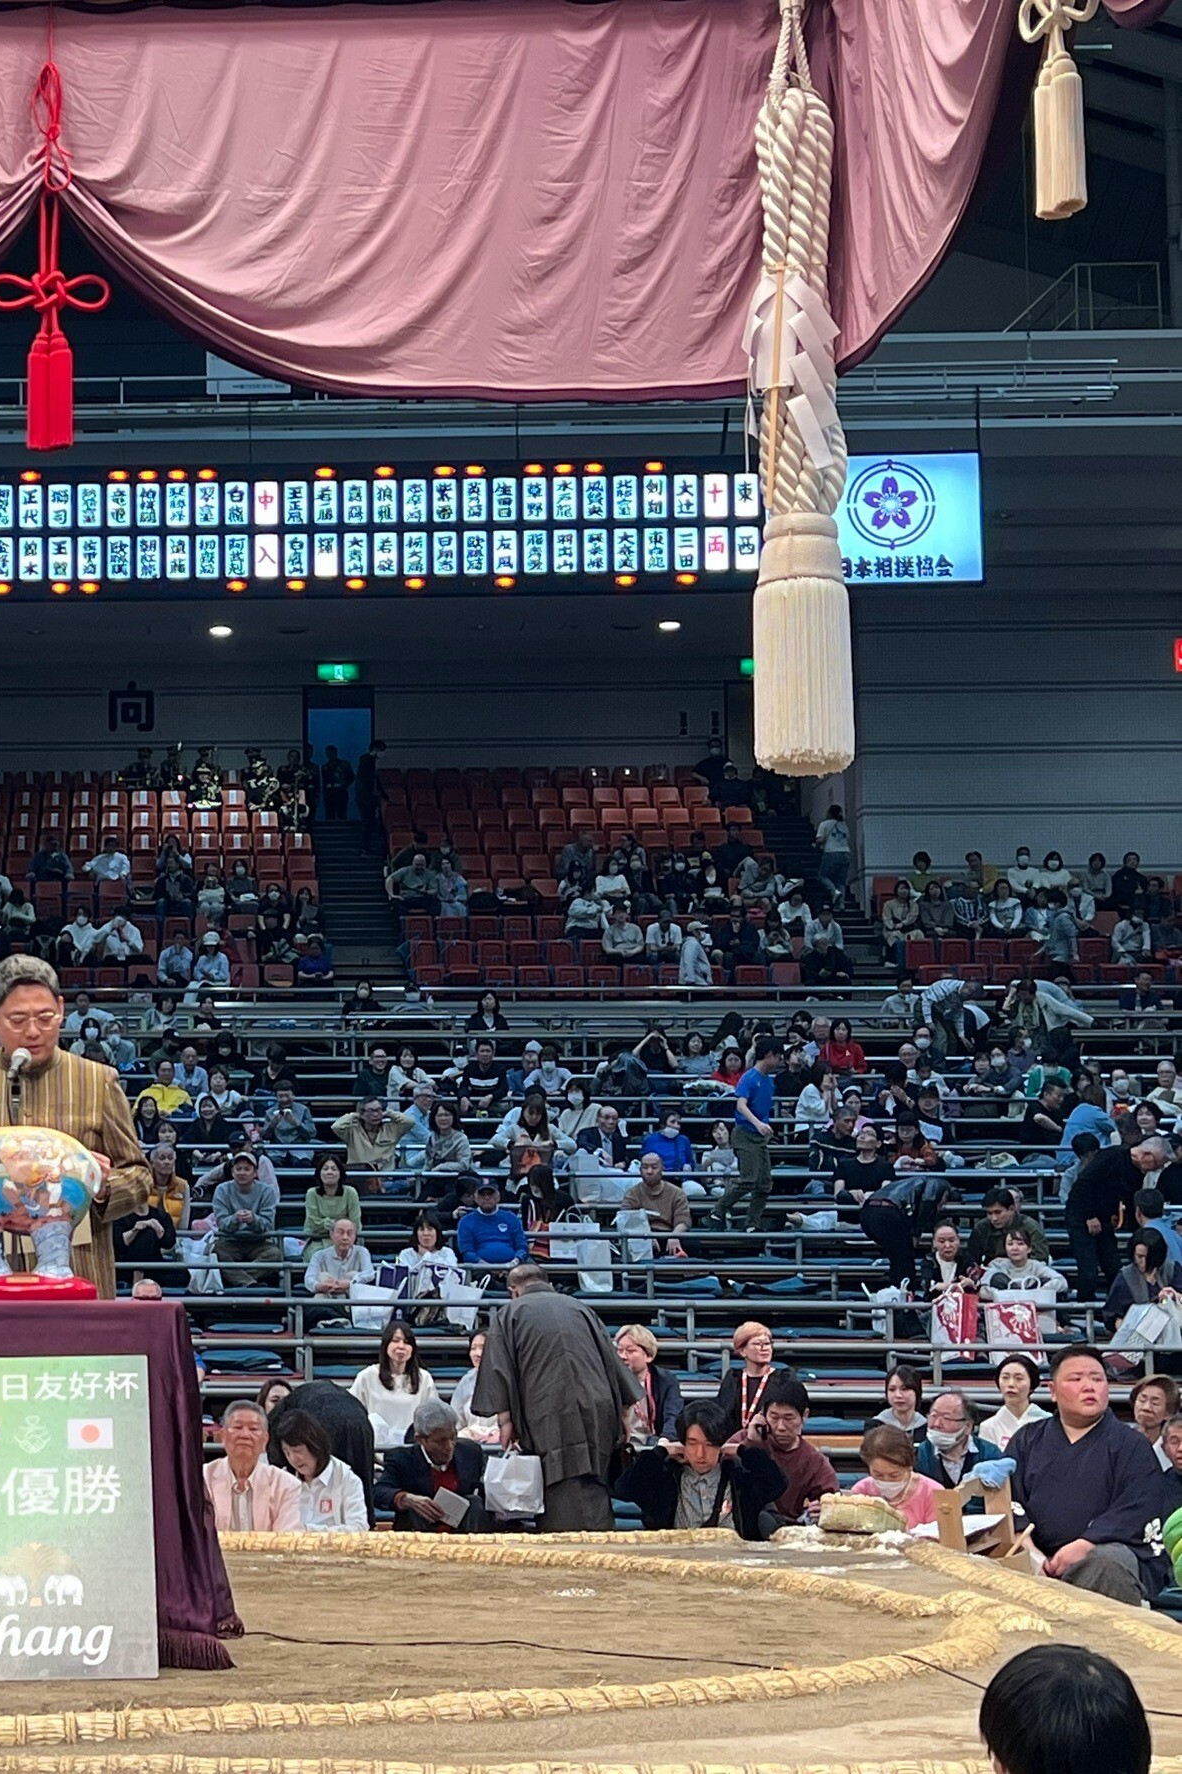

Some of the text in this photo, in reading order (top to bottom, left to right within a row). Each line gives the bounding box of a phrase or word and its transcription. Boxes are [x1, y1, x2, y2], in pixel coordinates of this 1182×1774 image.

[22, 489, 40, 525] 正代
[51, 489, 69, 525] 獅司
[228, 485, 245, 523] 白熊
[258, 490, 274, 510] 中
[496, 483, 513, 518] 生田目
[527, 482, 543, 517] 草野
[556, 480, 573, 517] 水戸龍
[647, 477, 665, 516] 剣翔
[677, 480, 695, 514] 大辻
[708, 484, 723, 502] 十
[737, 481, 752, 502] 東
[22, 540, 40, 576] 錦木
[257, 546, 276, 564] 入
[678, 532, 694, 568] 三田
[708, 535, 724, 553] 両
[737, 535, 755, 555] 西
[842, 554, 954, 579] 日本相撲協会
[109, 681, 154, 731] 向
